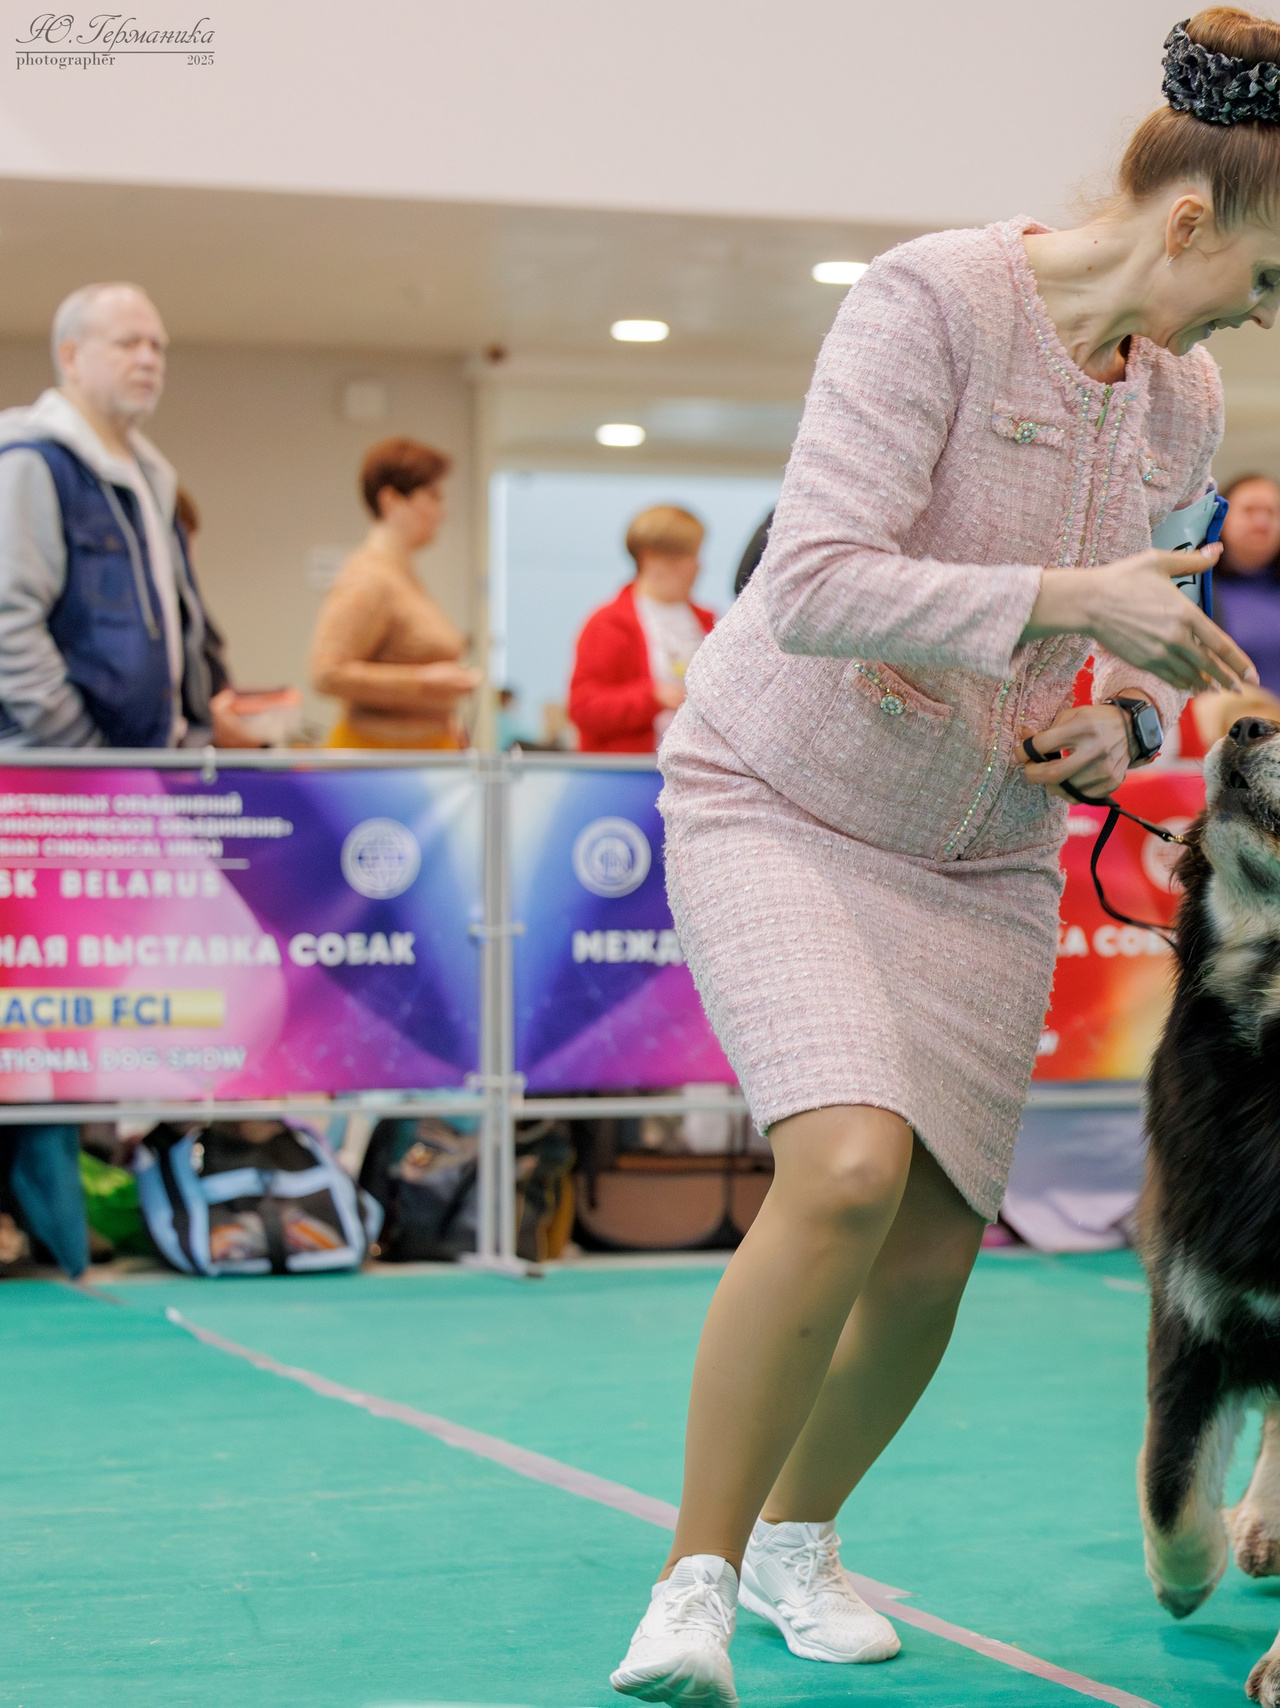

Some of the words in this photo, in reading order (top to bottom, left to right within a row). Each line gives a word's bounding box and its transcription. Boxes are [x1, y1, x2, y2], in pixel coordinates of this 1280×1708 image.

[60, 869, 221, 898] BELARUS
[78, 934, 282, 967] ВЫСТАВКА
[288, 932, 416, 967] СОБАК
[0, 996, 94, 1027] ACIB
[111, 996, 171, 1027] FCI
